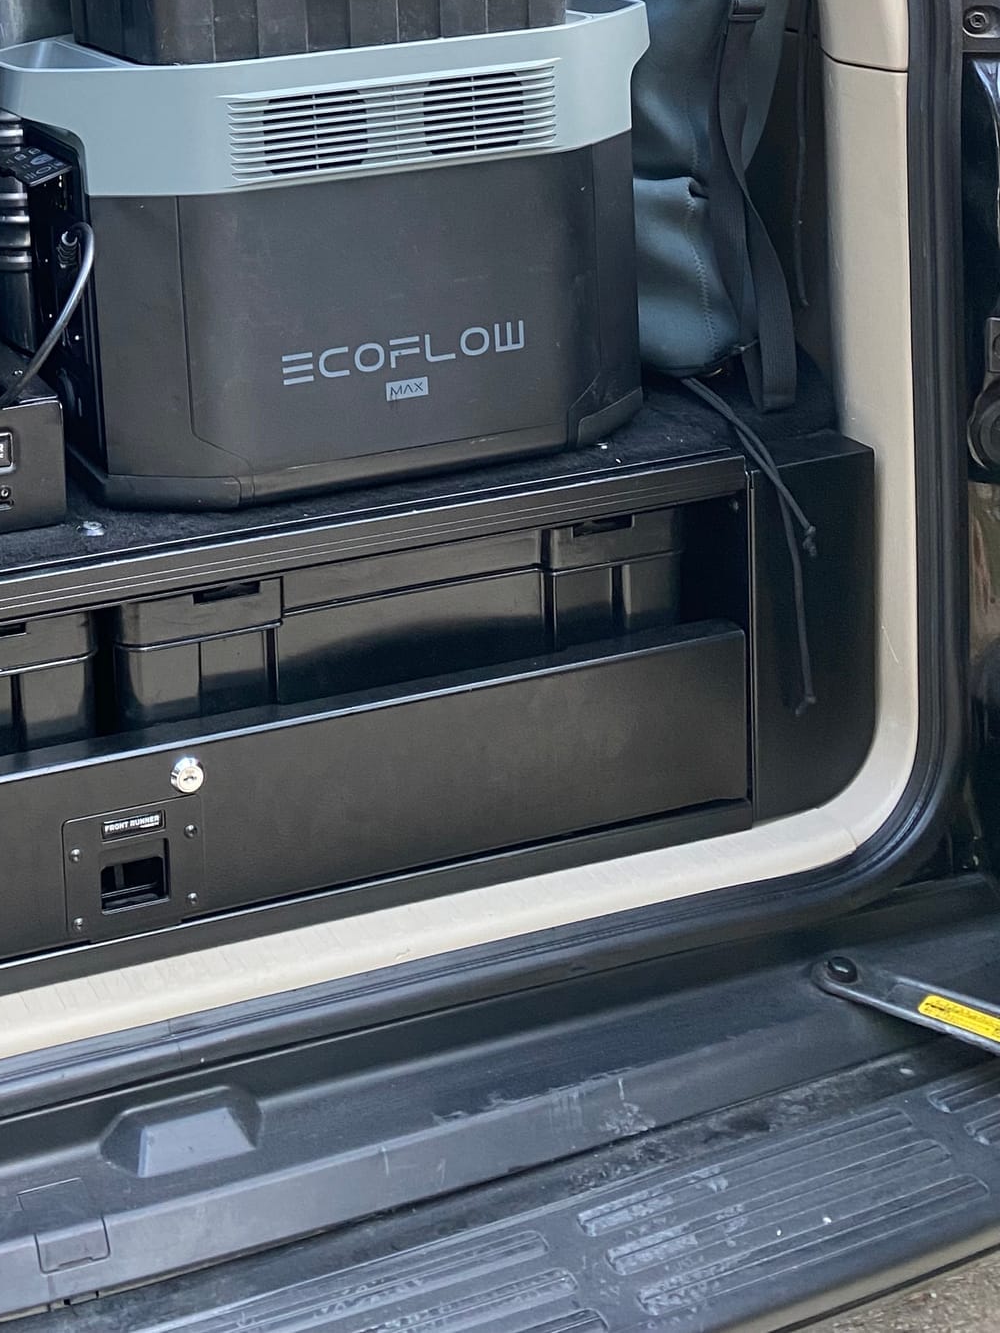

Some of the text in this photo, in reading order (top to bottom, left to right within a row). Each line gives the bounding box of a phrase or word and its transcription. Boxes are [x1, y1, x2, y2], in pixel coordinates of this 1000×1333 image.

[281, 319, 525, 386] ECOFLOW
[389, 380, 425, 397] MAX
[104, 821, 129, 833] FRONT
[129, 814, 160, 827] RUNNER
